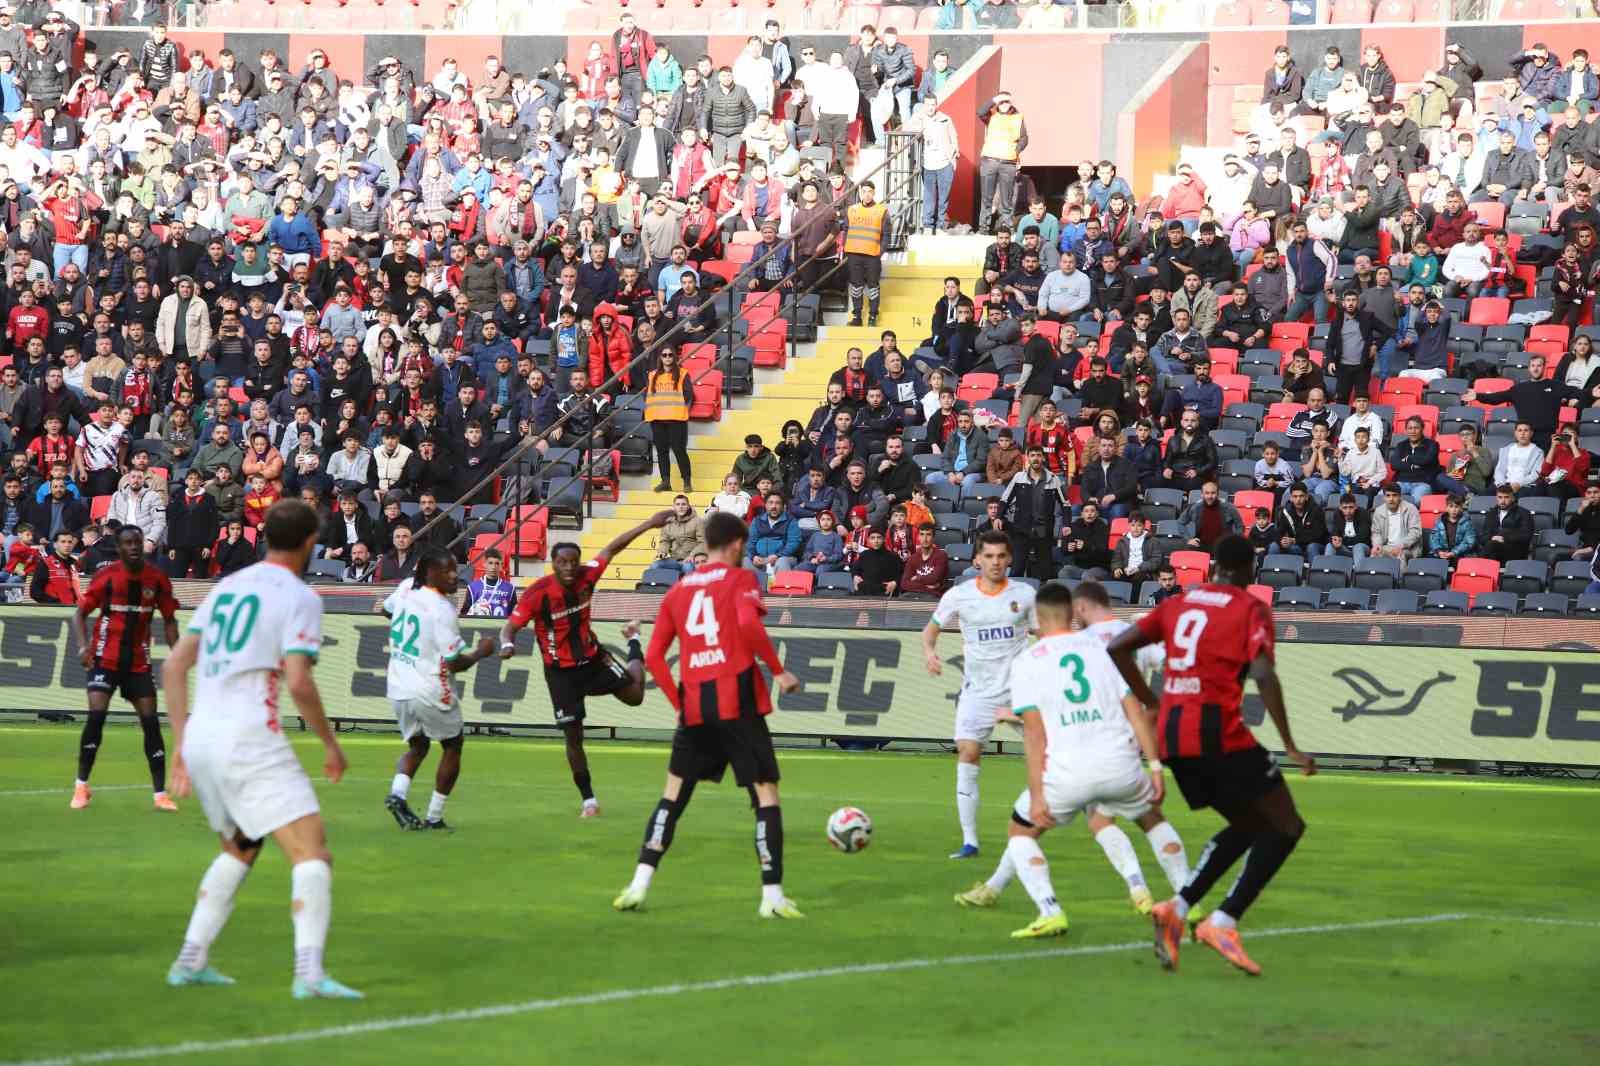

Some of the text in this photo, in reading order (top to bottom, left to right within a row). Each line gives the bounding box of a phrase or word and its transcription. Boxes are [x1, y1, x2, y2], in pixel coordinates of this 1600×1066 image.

[615, 567, 621, 578] 5
[207, 593, 260, 655] 50
[390, 608, 420, 658] 42
[685, 589, 720, 647] 4
[978, 626, 1015, 641] TAV
[1168, 609, 1208, 671] 9
[689, 649, 726, 668] ARDA
[1059, 653, 1091, 704] 3
[1060, 709, 1103, 727] LIMA
